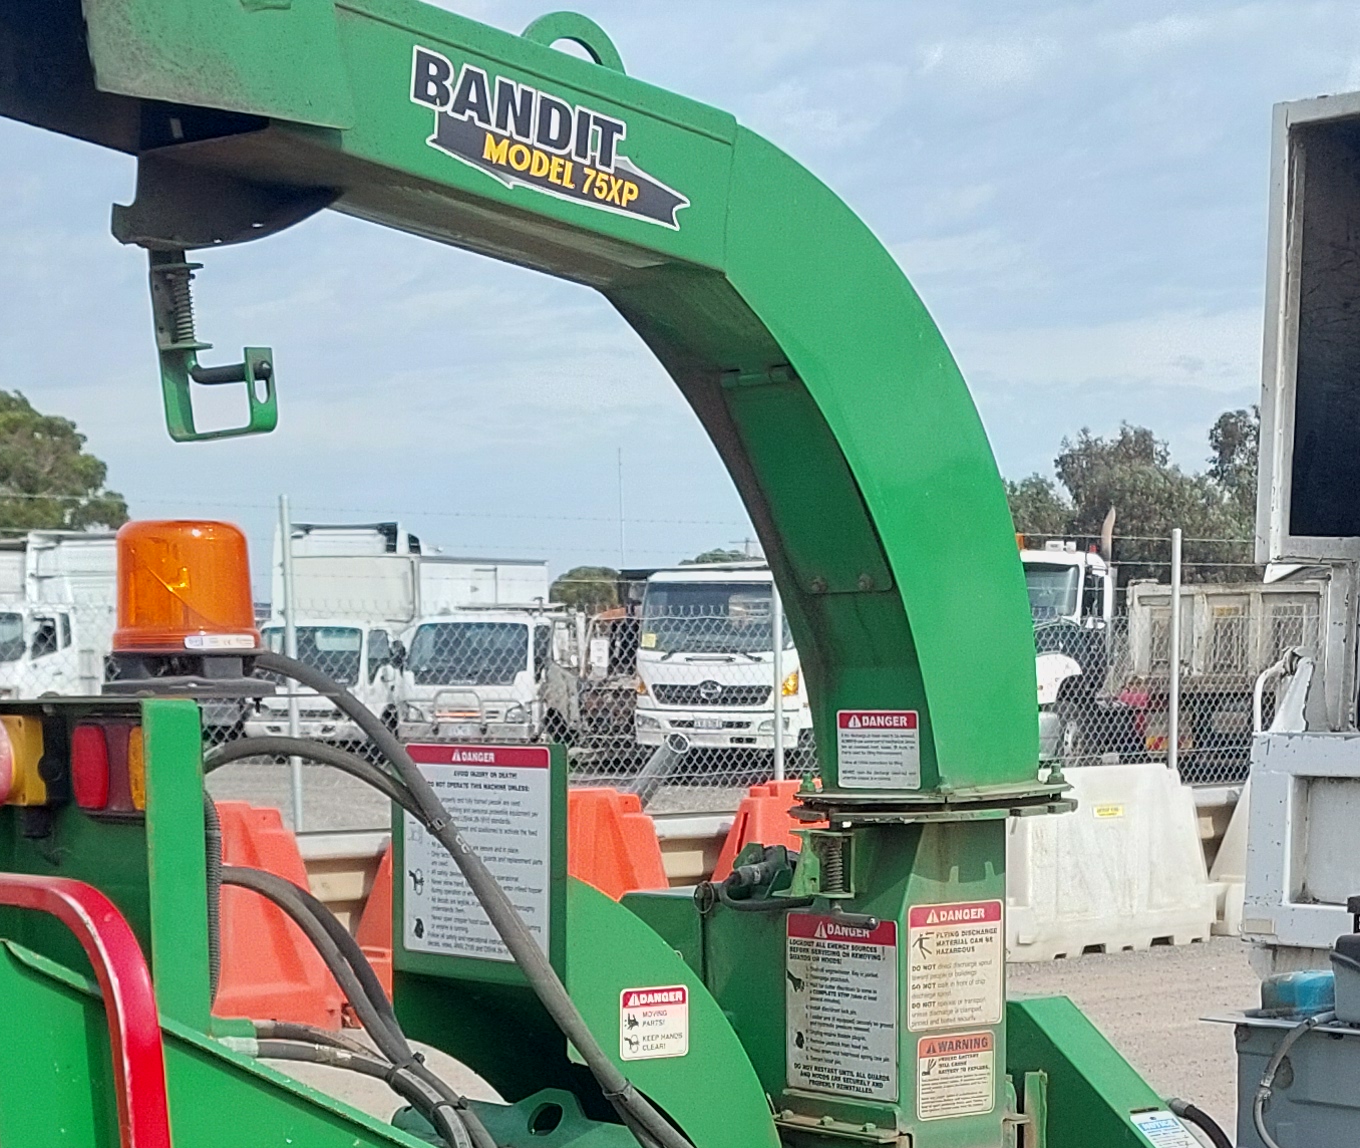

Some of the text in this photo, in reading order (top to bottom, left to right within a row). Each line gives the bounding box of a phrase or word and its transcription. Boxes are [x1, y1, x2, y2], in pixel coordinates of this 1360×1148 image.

[413, 46, 624, 171] BANDIT
[482, 132, 639, 208] MODEL 75XP
[862, 716, 907, 727] DANGER
[462, 752, 495, 763] DANGER
[939, 908, 985, 921] DANGER
[827, 923, 870, 938] DANGER
[936, 928, 998, 939] FLYING DISCHARGE
[936, 938, 968, 947] MATERIAL
[936, 946, 975, 955] HAZARDOUS
[640, 991, 683, 1004] DANGER
[642, 1010, 667, 1018] MOVING
[642, 1032, 683, 1042] KEEP HANDS
[938, 1037, 988, 1052] WARNING
